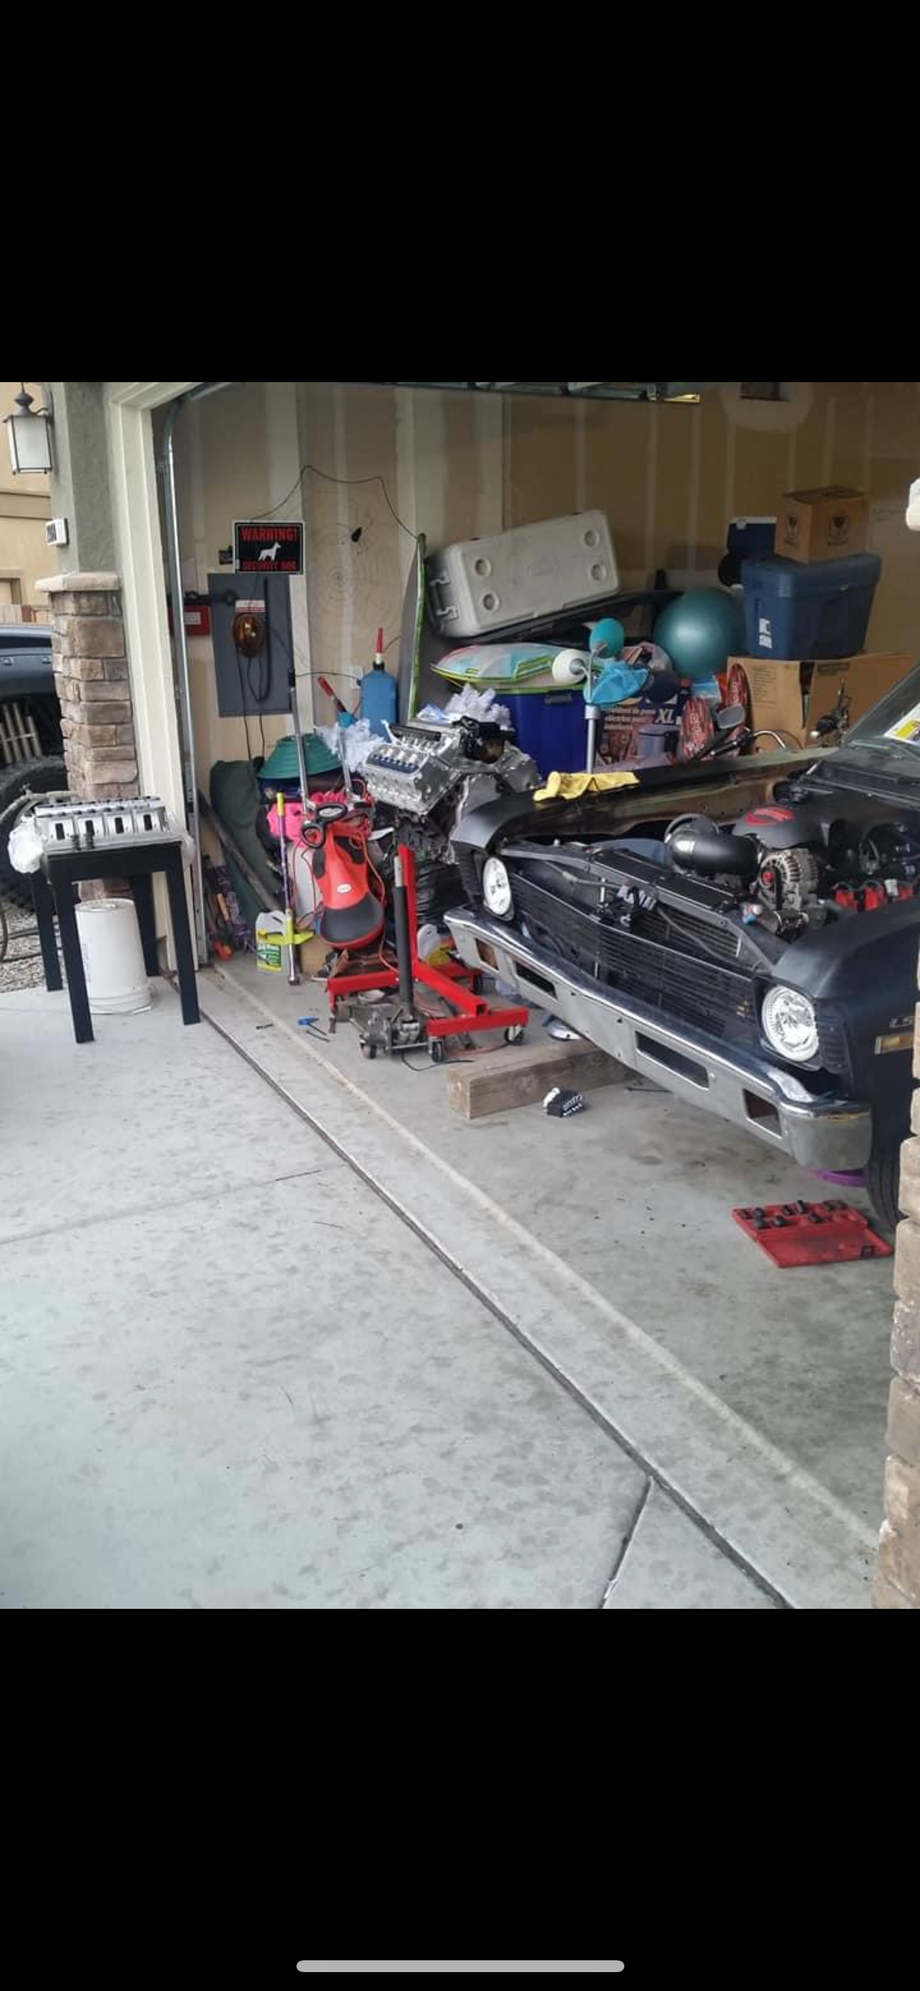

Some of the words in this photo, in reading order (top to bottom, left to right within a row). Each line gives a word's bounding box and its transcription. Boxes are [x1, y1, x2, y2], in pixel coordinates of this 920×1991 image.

[240, 526, 298, 542] WARNING!
[242, 560, 278, 570] SECURITY
[281, 560, 297, 570] DOG
[654, 708, 675, 724] XL
